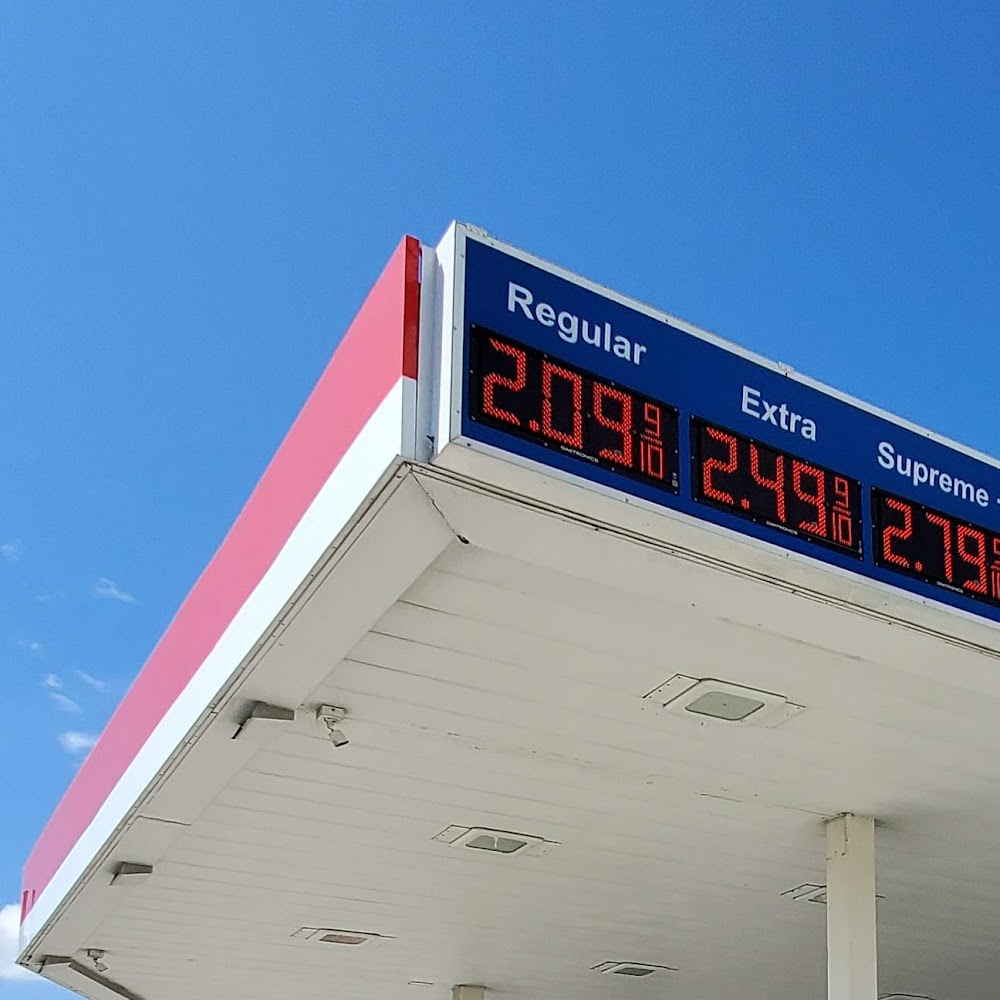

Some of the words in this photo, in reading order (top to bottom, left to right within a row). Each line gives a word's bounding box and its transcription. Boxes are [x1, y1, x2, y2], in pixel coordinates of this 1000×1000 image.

[508, 281, 648, 366] Regular
[482, 337, 633, 468] 2.09
[741, 384, 817, 443] Extra
[703, 426, 828, 538] 2.49
[877, 441, 990, 508] Supreme
[883, 497, 988, 595] 2.79
